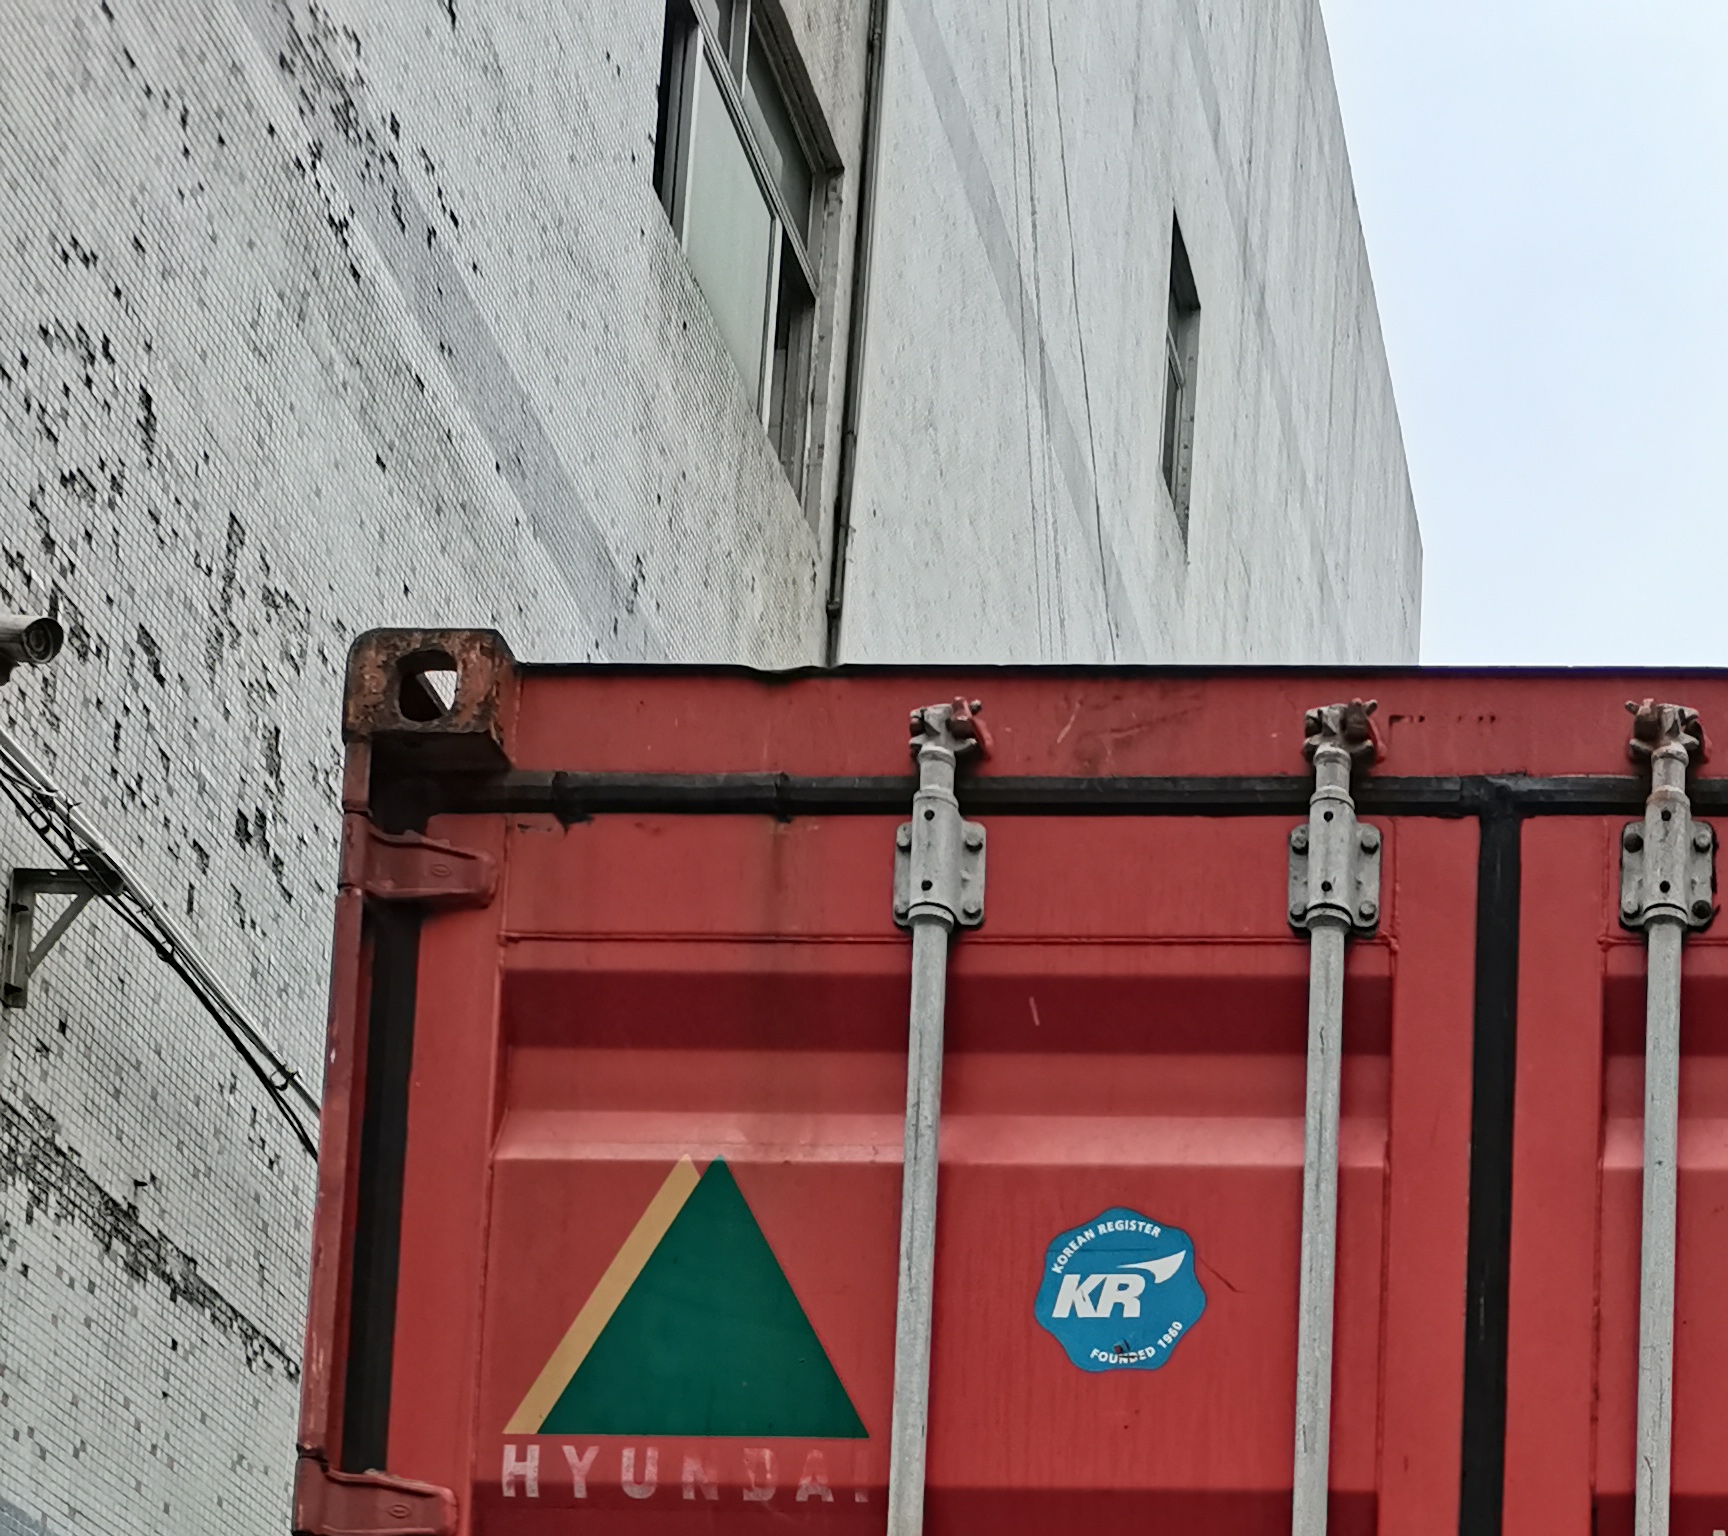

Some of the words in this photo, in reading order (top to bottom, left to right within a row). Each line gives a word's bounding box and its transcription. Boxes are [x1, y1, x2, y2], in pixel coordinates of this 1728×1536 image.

[1051, 1228, 1096, 1274] KOREAN
[1097, 1220, 1162, 1238] REGISTER
[1051, 1274, 1146, 1318] KR
[1090, 1346, 1156, 1364] FOUNDED
[1157, 1321, 1183, 1349] 1960
[502, 1444, 870, 1502] HYUNDAI
